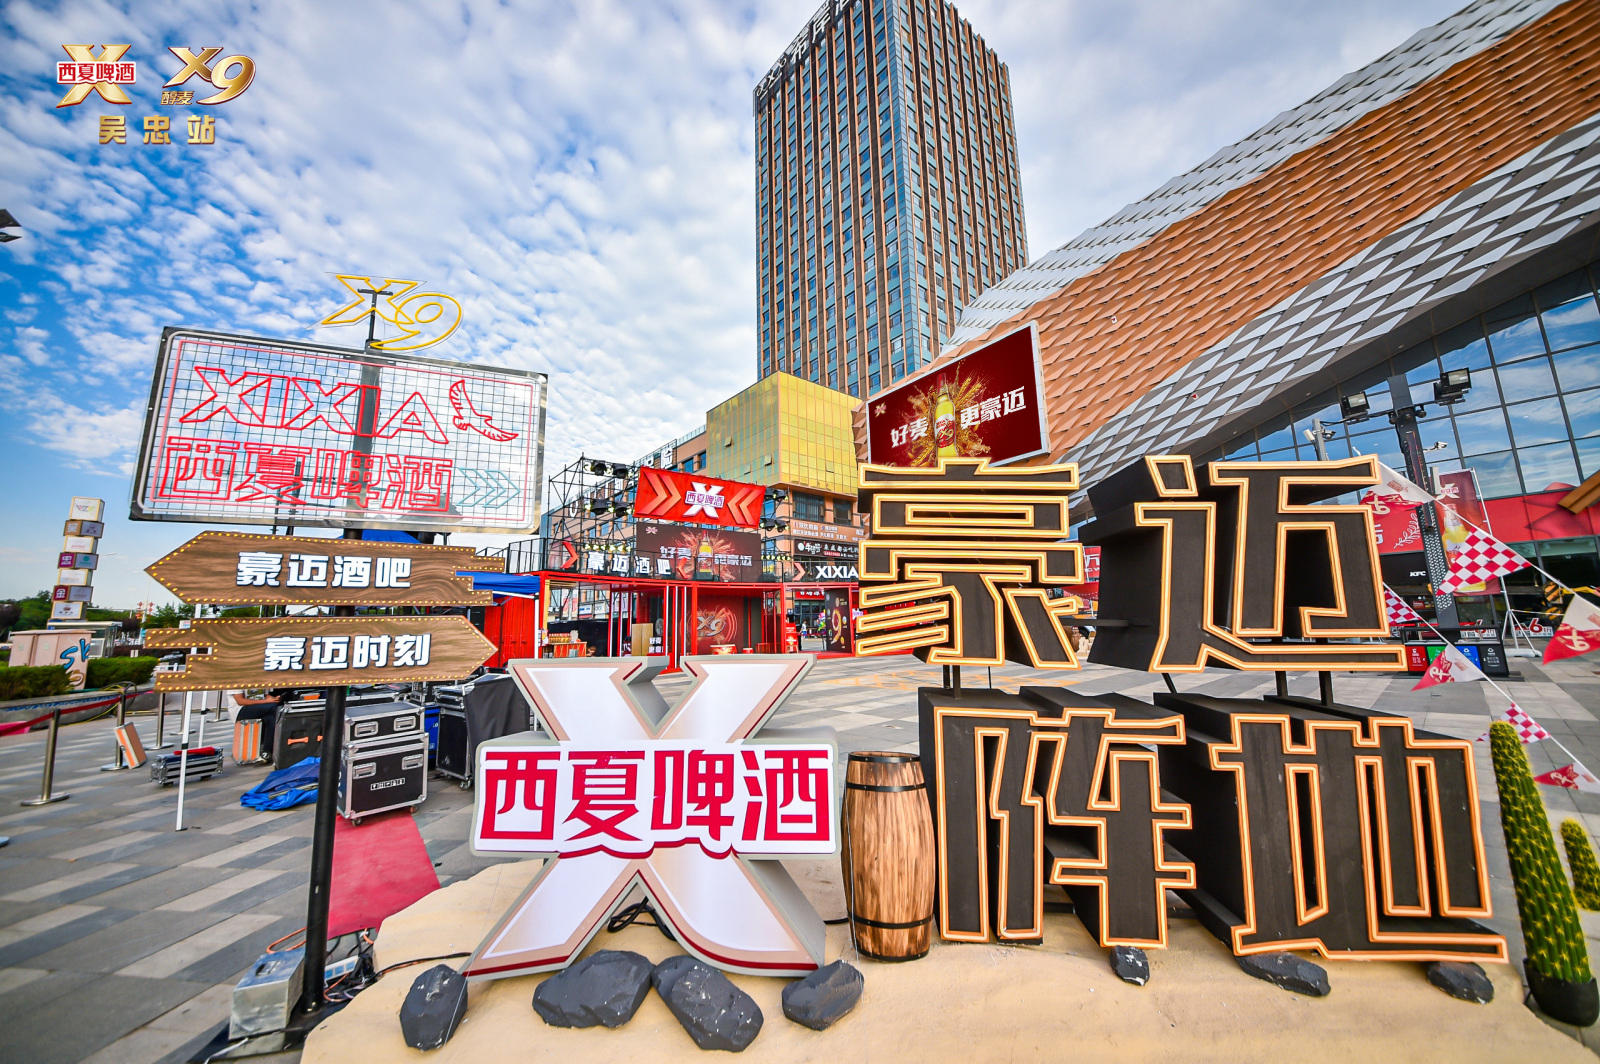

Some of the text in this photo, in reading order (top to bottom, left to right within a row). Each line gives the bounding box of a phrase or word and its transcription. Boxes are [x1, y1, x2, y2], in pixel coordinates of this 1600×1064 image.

[321, 275, 462, 351] X9
[178, 366, 450, 445] XIXIA
[890, 386, 1027, 448] 好麦 更豪迈
[158, 436, 454, 513] 西夏啤酒
[236, 551, 412, 588] 豪迈酒吧
[588, 551, 672, 575] 豪迈酒吧
[815, 565, 859, 579] XIXIA
[856, 454, 1408, 674] 豪迈
[263, 633, 432, 671] 豪迈时刻
[480, 749, 829, 841] 西夏啤酒
[934, 706, 1510, 965] 阵地
